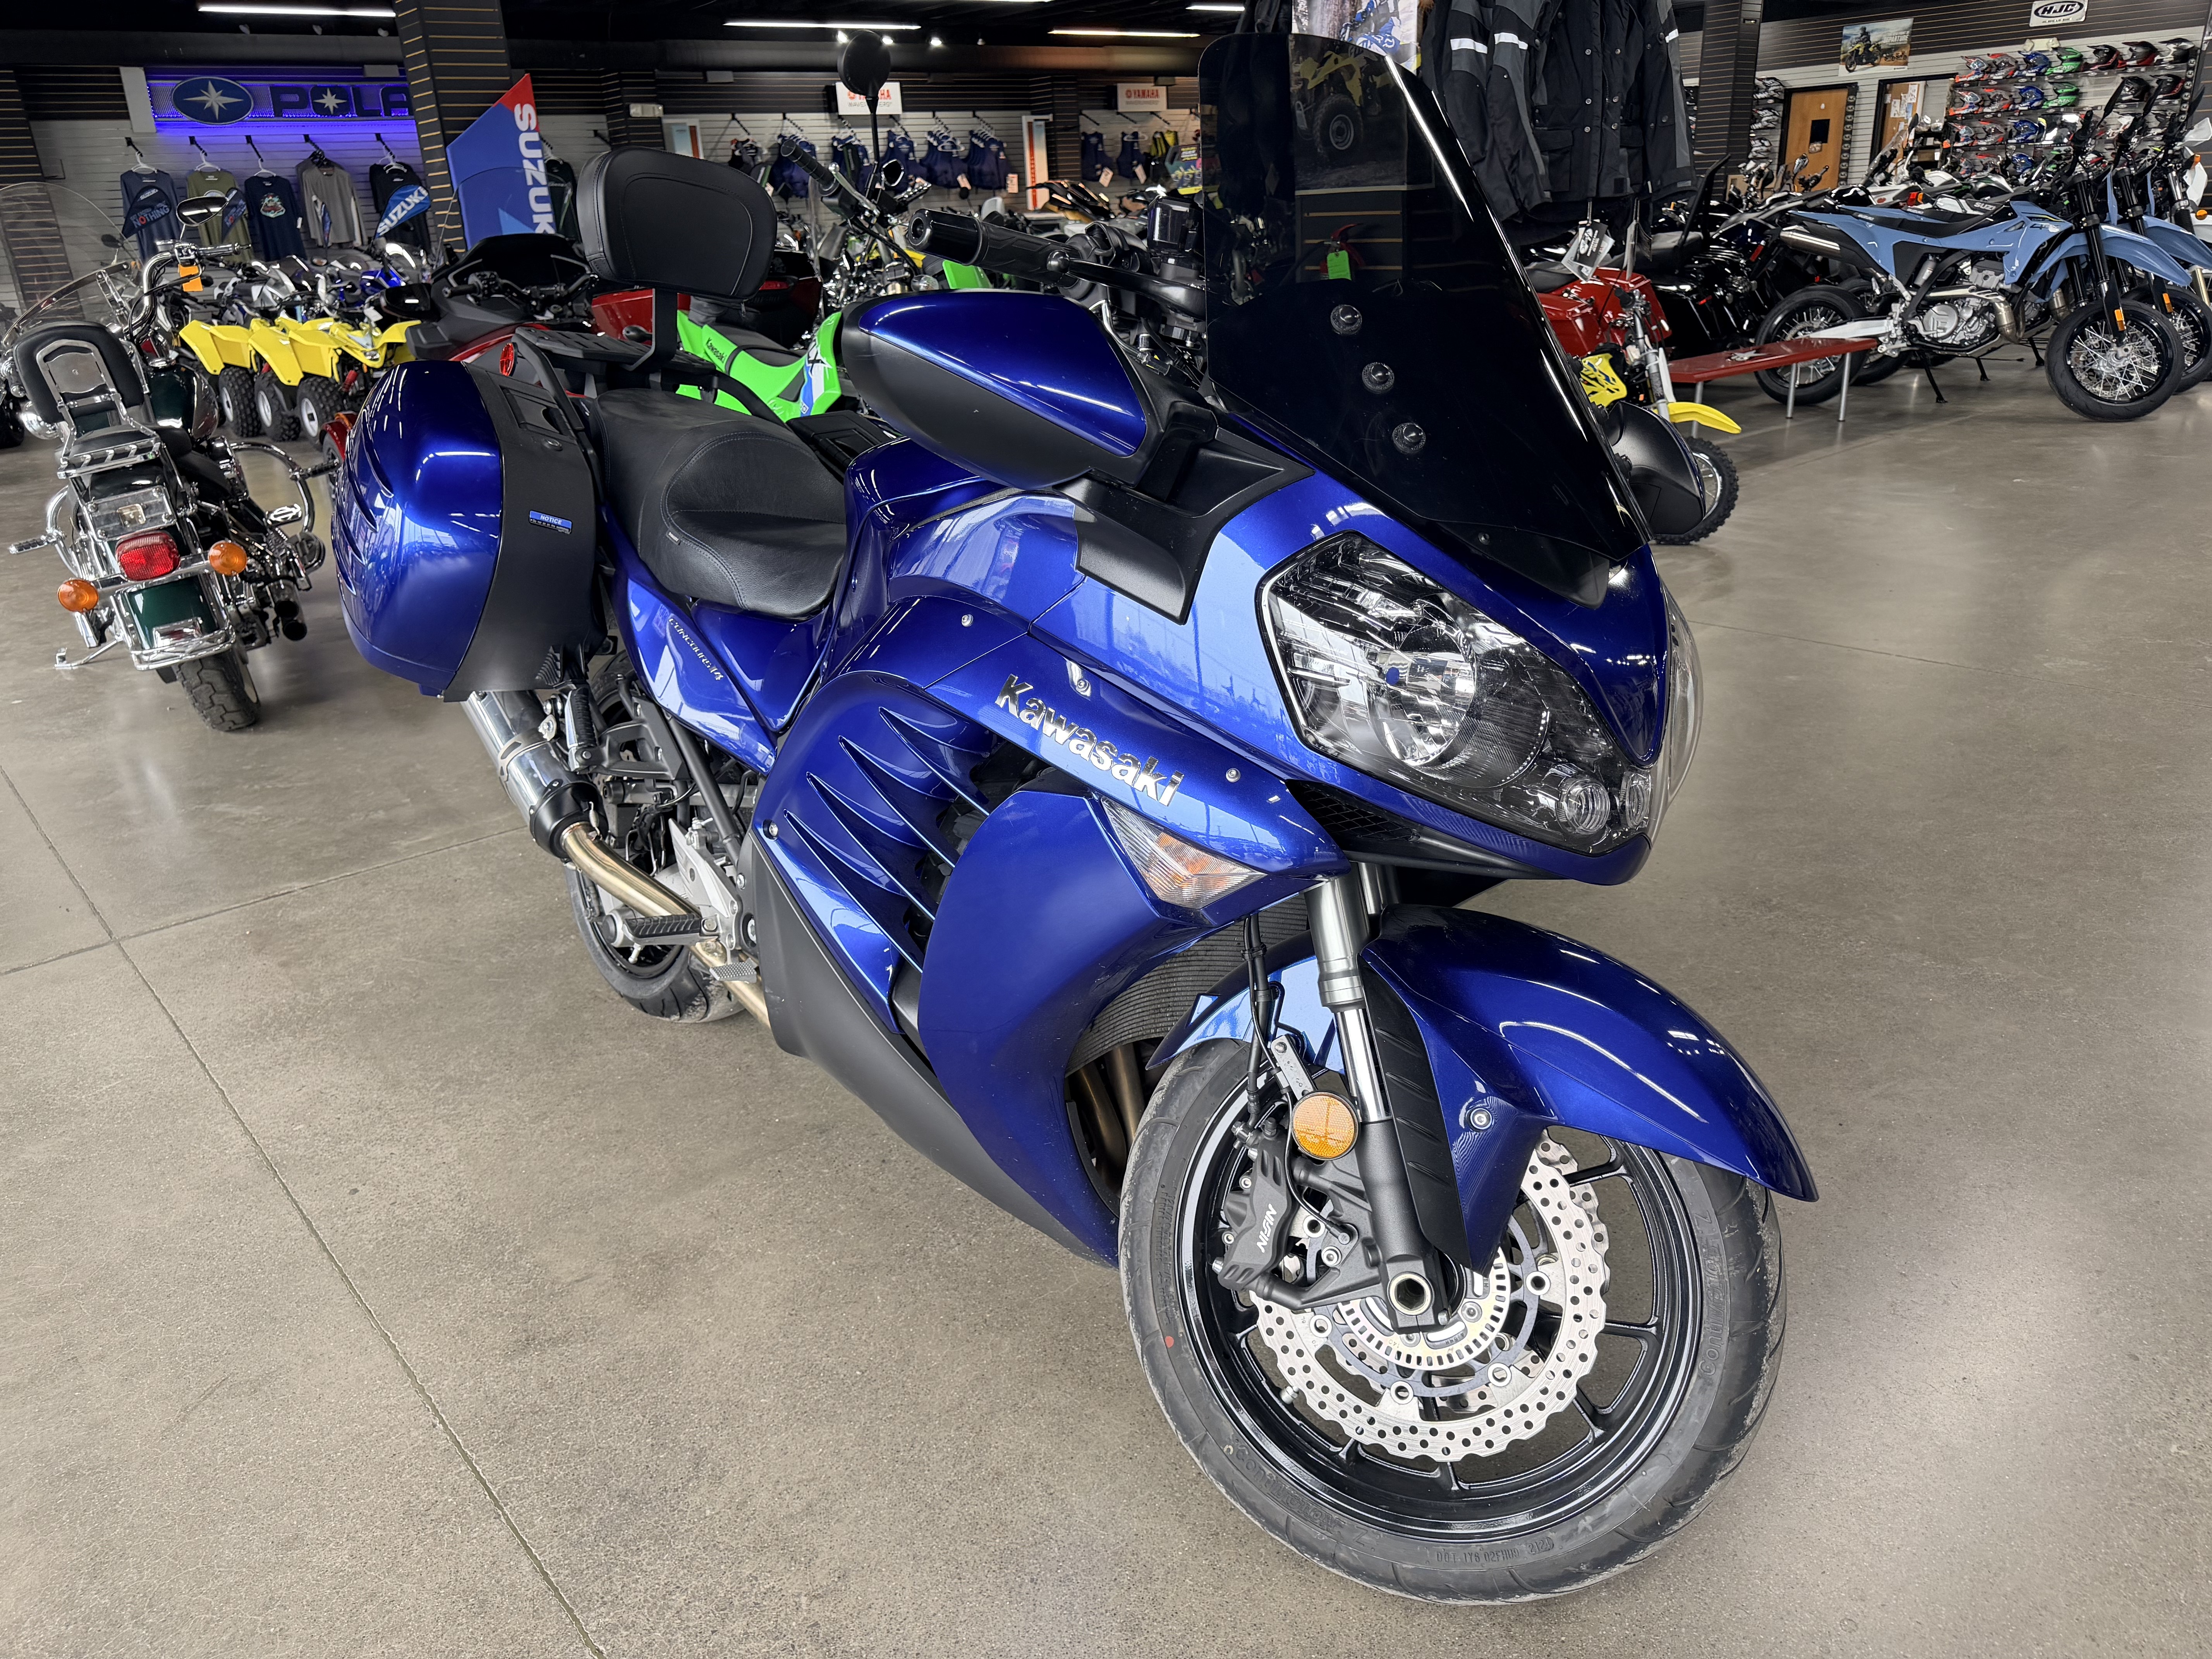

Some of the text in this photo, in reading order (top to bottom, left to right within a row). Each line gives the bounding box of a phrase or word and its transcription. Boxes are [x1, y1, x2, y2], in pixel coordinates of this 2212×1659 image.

[2041, 3, 2077, 15] HJC
[269, 86, 411, 117] POLA
[514, 103, 556, 234] SUZUK
[131, 204, 170, 228] NOTHING
[376, 186, 428, 236] SUZUKI
[1974, 202, 1996, 211] SUZ
[706, 337, 727, 363] Kawasaki
[540, 515, 562, 525] NOTICE
[994, 673, 1185, 807] Kawasaki
[1256, 1203, 1277, 1253] NISSIN
[1437, 1551, 1457, 1563] DOT
